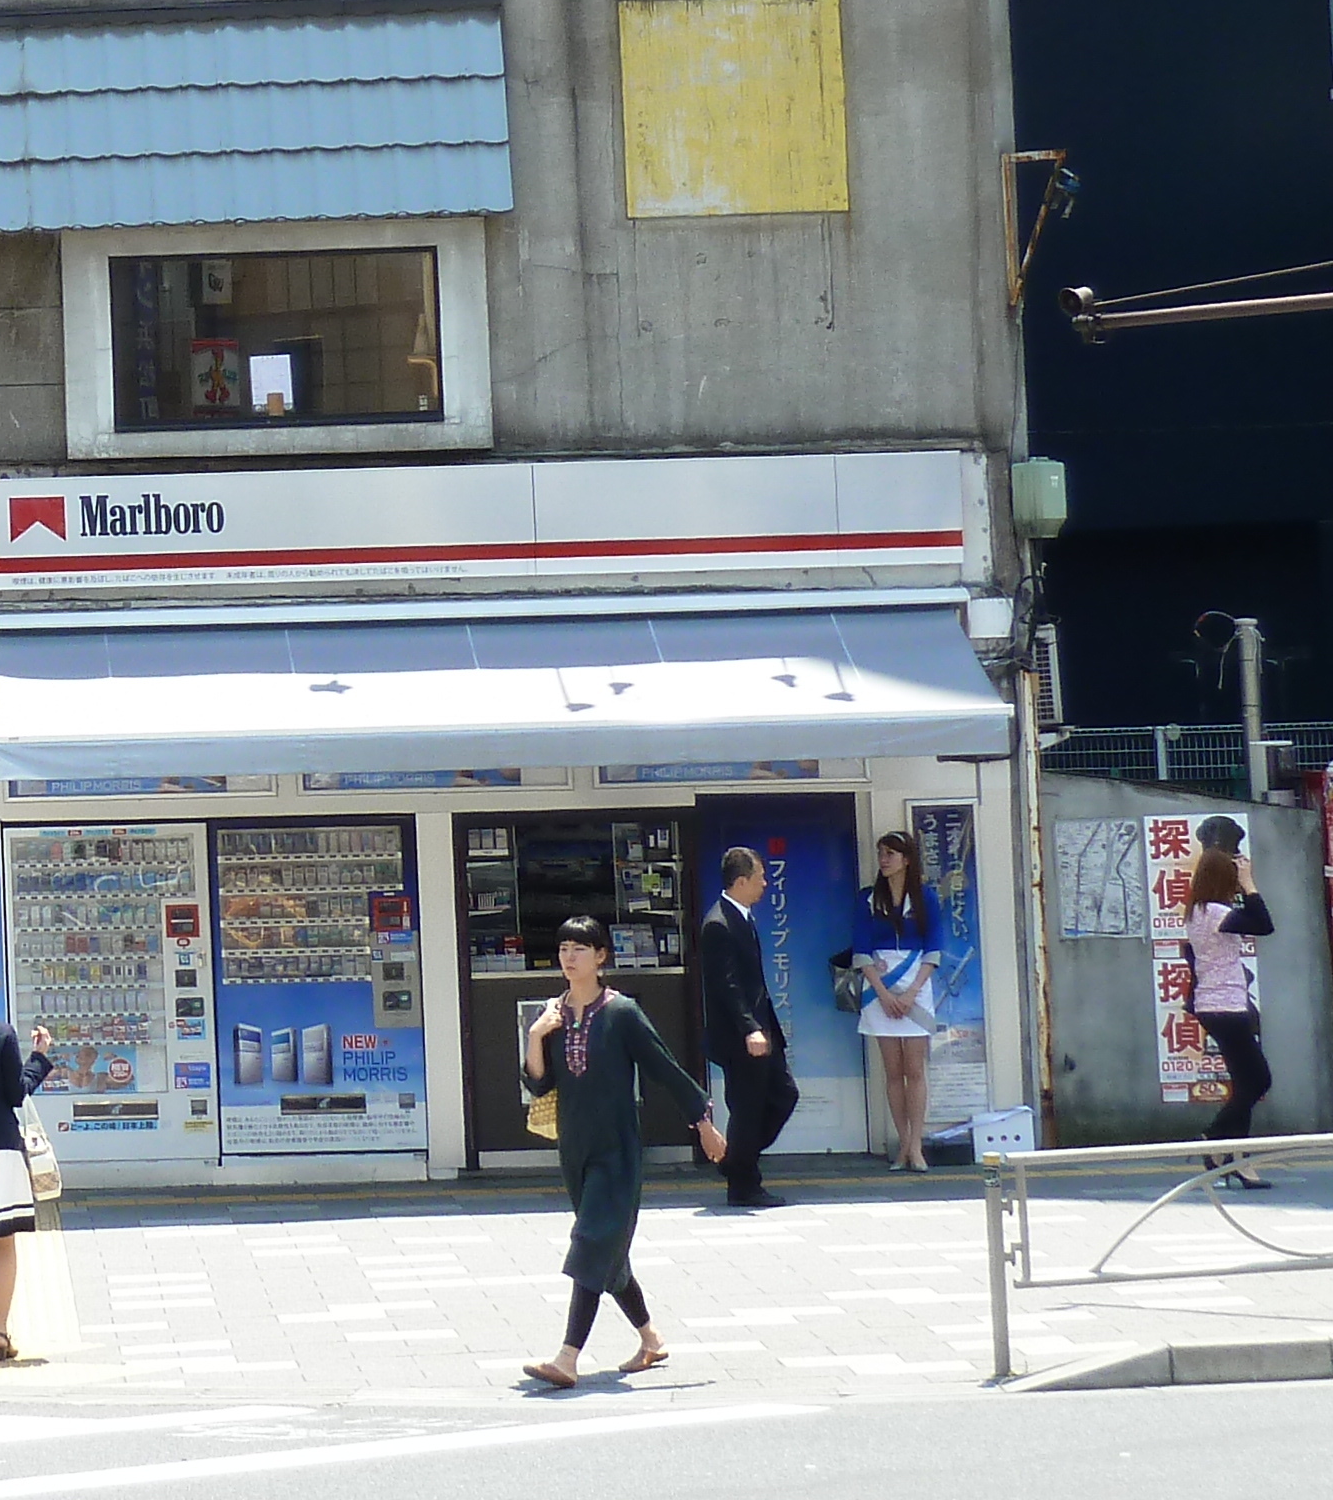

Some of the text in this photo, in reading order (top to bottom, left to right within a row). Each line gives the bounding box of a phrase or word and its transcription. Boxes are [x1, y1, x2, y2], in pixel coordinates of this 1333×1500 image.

[78, 492, 226, 538] Marlboro
[1148, 818, 1193, 911] 探偵
[768, 860, 791, 948] フィリップ
[1157, 961, 1204, 1054] 探偵
[342, 1034, 377, 1049] NEW
[343, 1051, 397, 1066] PHILIP
[343, 1067, 409, 1082] MORRIS
